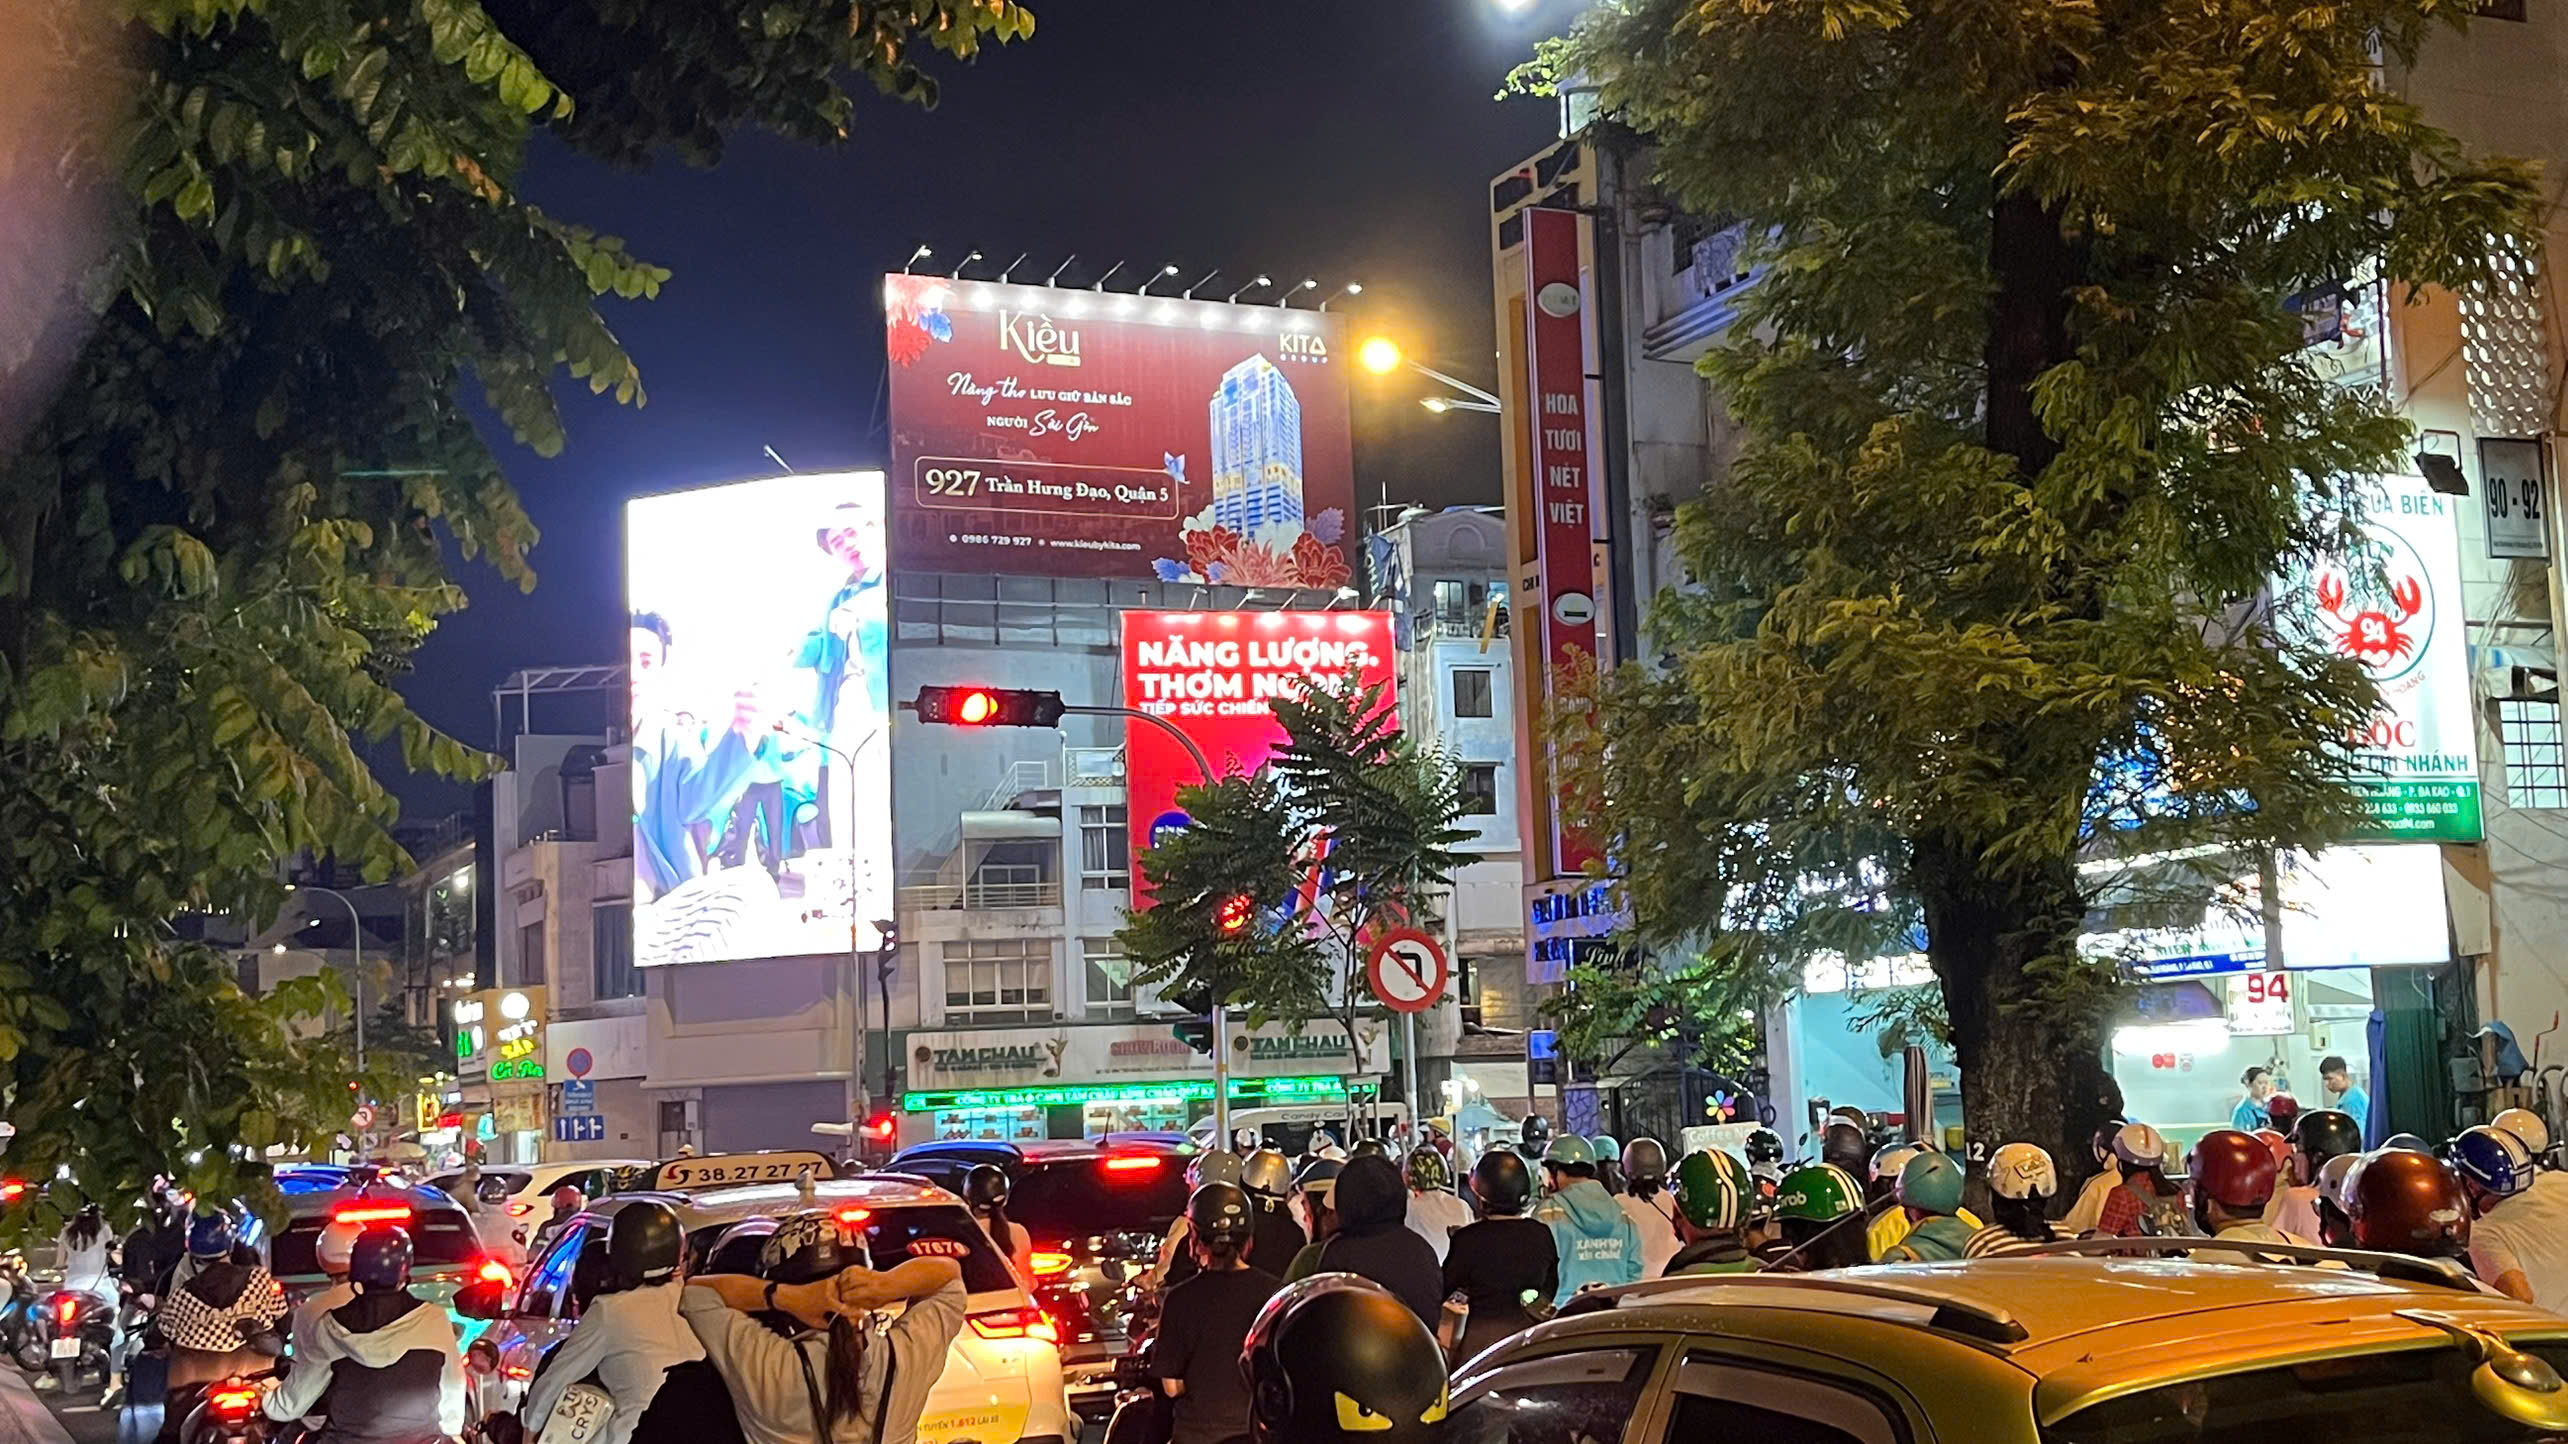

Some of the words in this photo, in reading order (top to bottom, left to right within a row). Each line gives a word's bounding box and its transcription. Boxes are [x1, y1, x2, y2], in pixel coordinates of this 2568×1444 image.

[999, 309, 1080, 364] Kiều
[1280, 333, 1328, 355] KITA
[946, 372, 998, 406] Nàng
[1545, 393, 1578, 416] HOA
[986, 416, 1028, 429] NGƯỜI
[1545, 428, 1581, 451] TƯƠI
[925, 468, 981, 497] 927
[985, 475, 1024, 494] Trần
[1027, 479, 1073, 500] Hưng
[1075, 483, 1111, 501] Đạo,
[1114, 485, 1157, 503] Quận
[1158, 487, 1169, 501] 5
[2489, 477, 2508, 519] 90
[2521, 479, 2541, 520] 92
[1549, 500, 1584, 529] VIỆT
[2359, 617, 2388, 644] 94
[1138, 635, 1240, 668] NĂNG
[1248, 637, 1379, 672] LƯỢNG.
[1138, 669, 1243, 699] THƠM
[1139, 698, 1176, 716] TIẾP
[1180, 700, 1215, 715] SỨC
[1217, 698, 1270, 715] CHIẾN
[2406, 750, 2469, 772] NHÁNH
[2248, 973, 2288, 1004] 94
[1966, 1141, 1985, 1161] 12
[698, 1166, 760, 1182] 38.27
[766, 1164, 792, 1178] 27
[797, 1161, 823, 1175] 27
